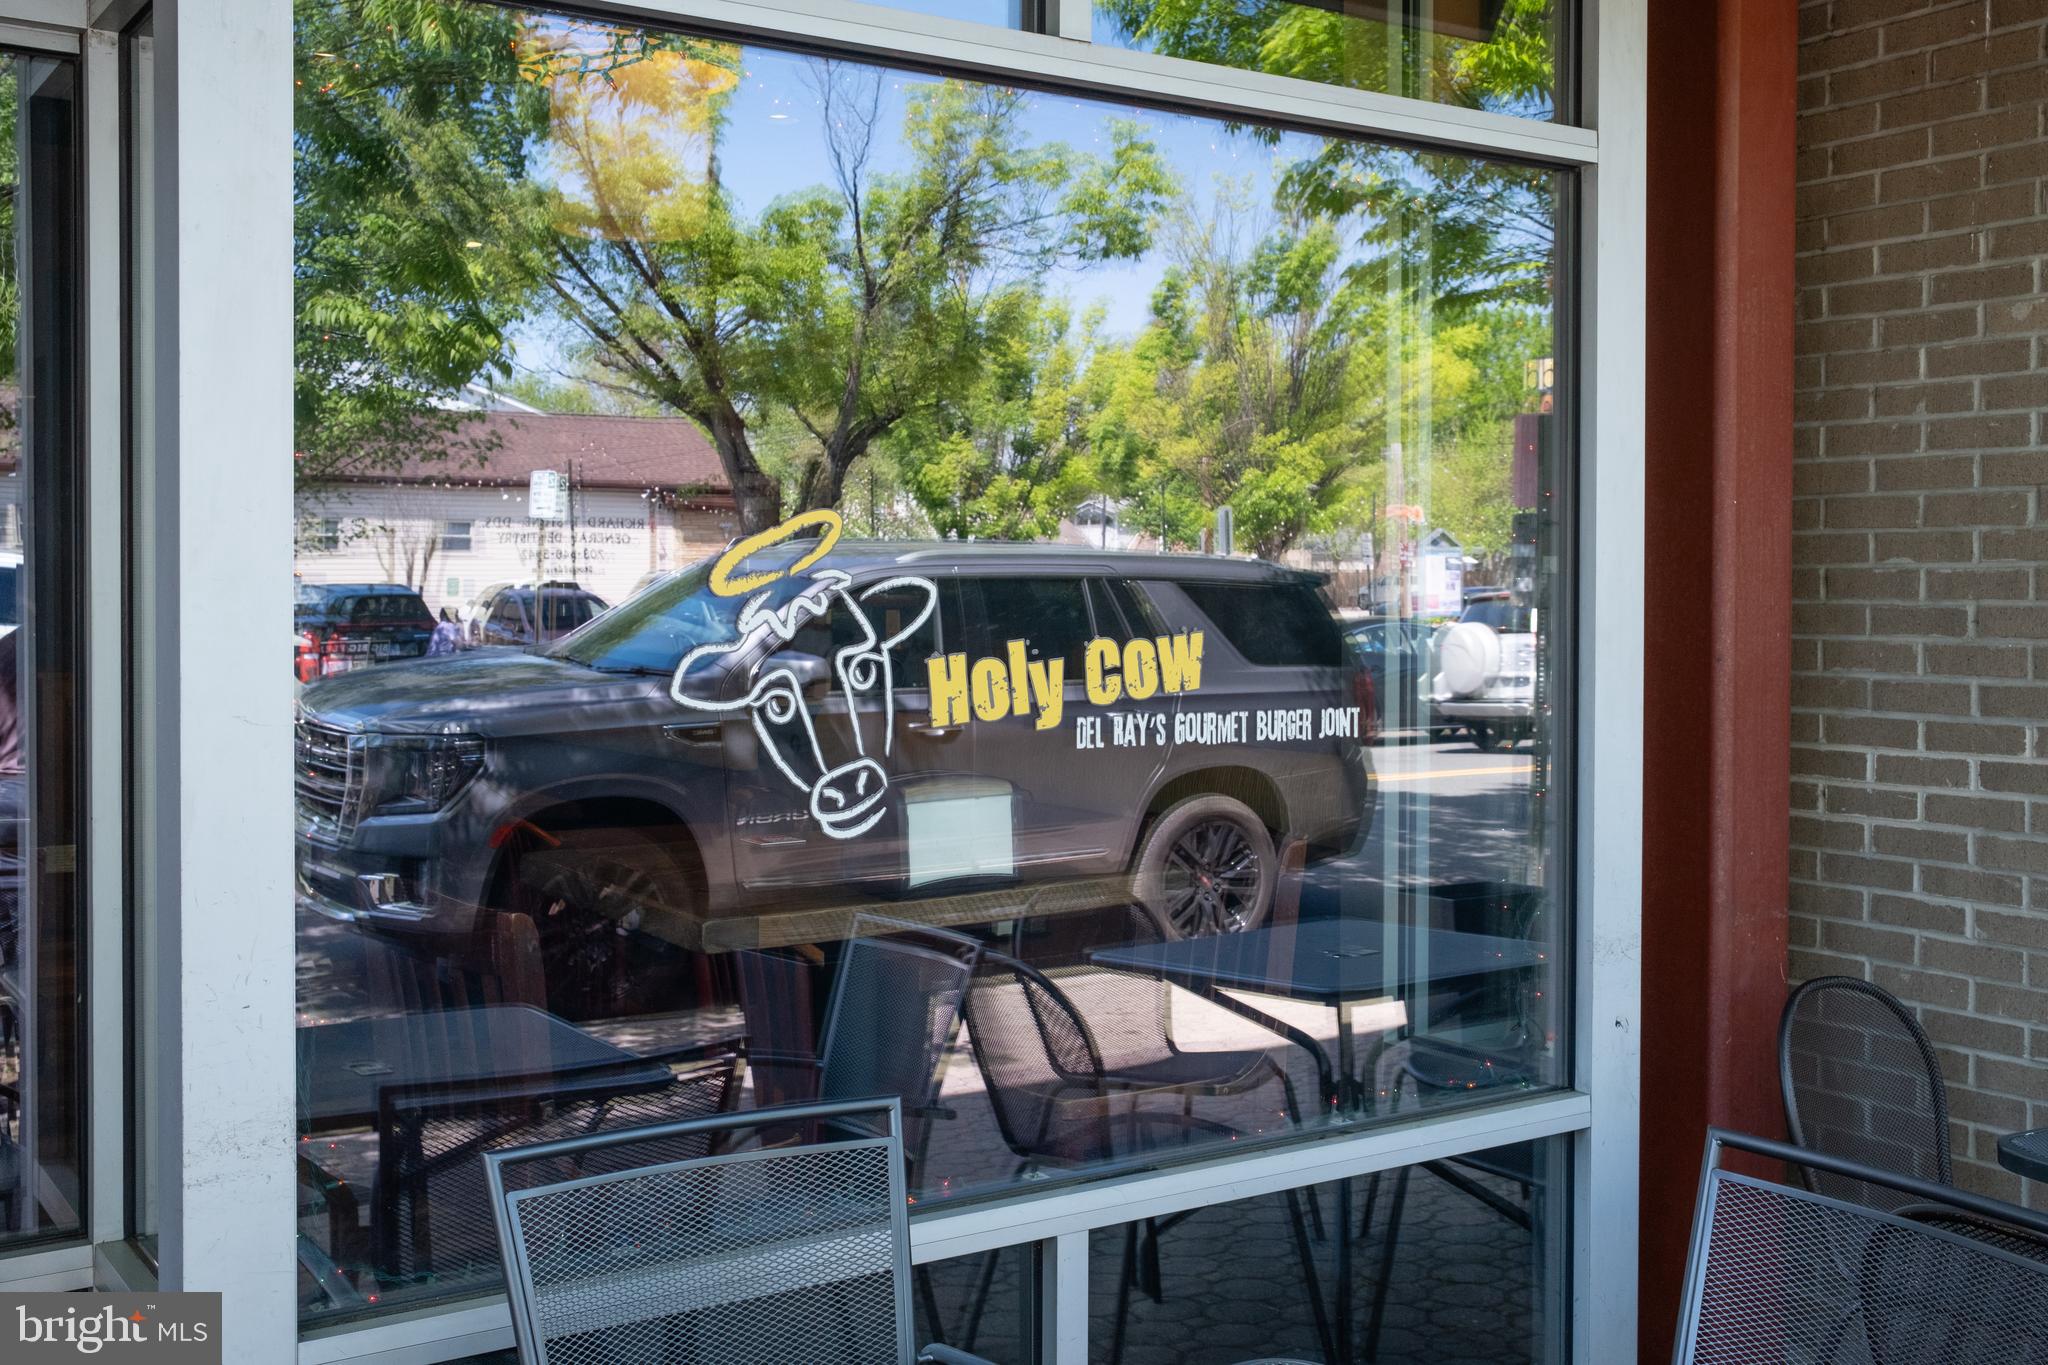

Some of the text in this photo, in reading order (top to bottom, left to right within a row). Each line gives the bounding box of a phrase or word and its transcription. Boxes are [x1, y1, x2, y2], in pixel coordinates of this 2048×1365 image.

[926, 638, 1065, 731] Holy
[1076, 707, 1361, 749] DEL RAY'S GOURMET BURGER JOINT
